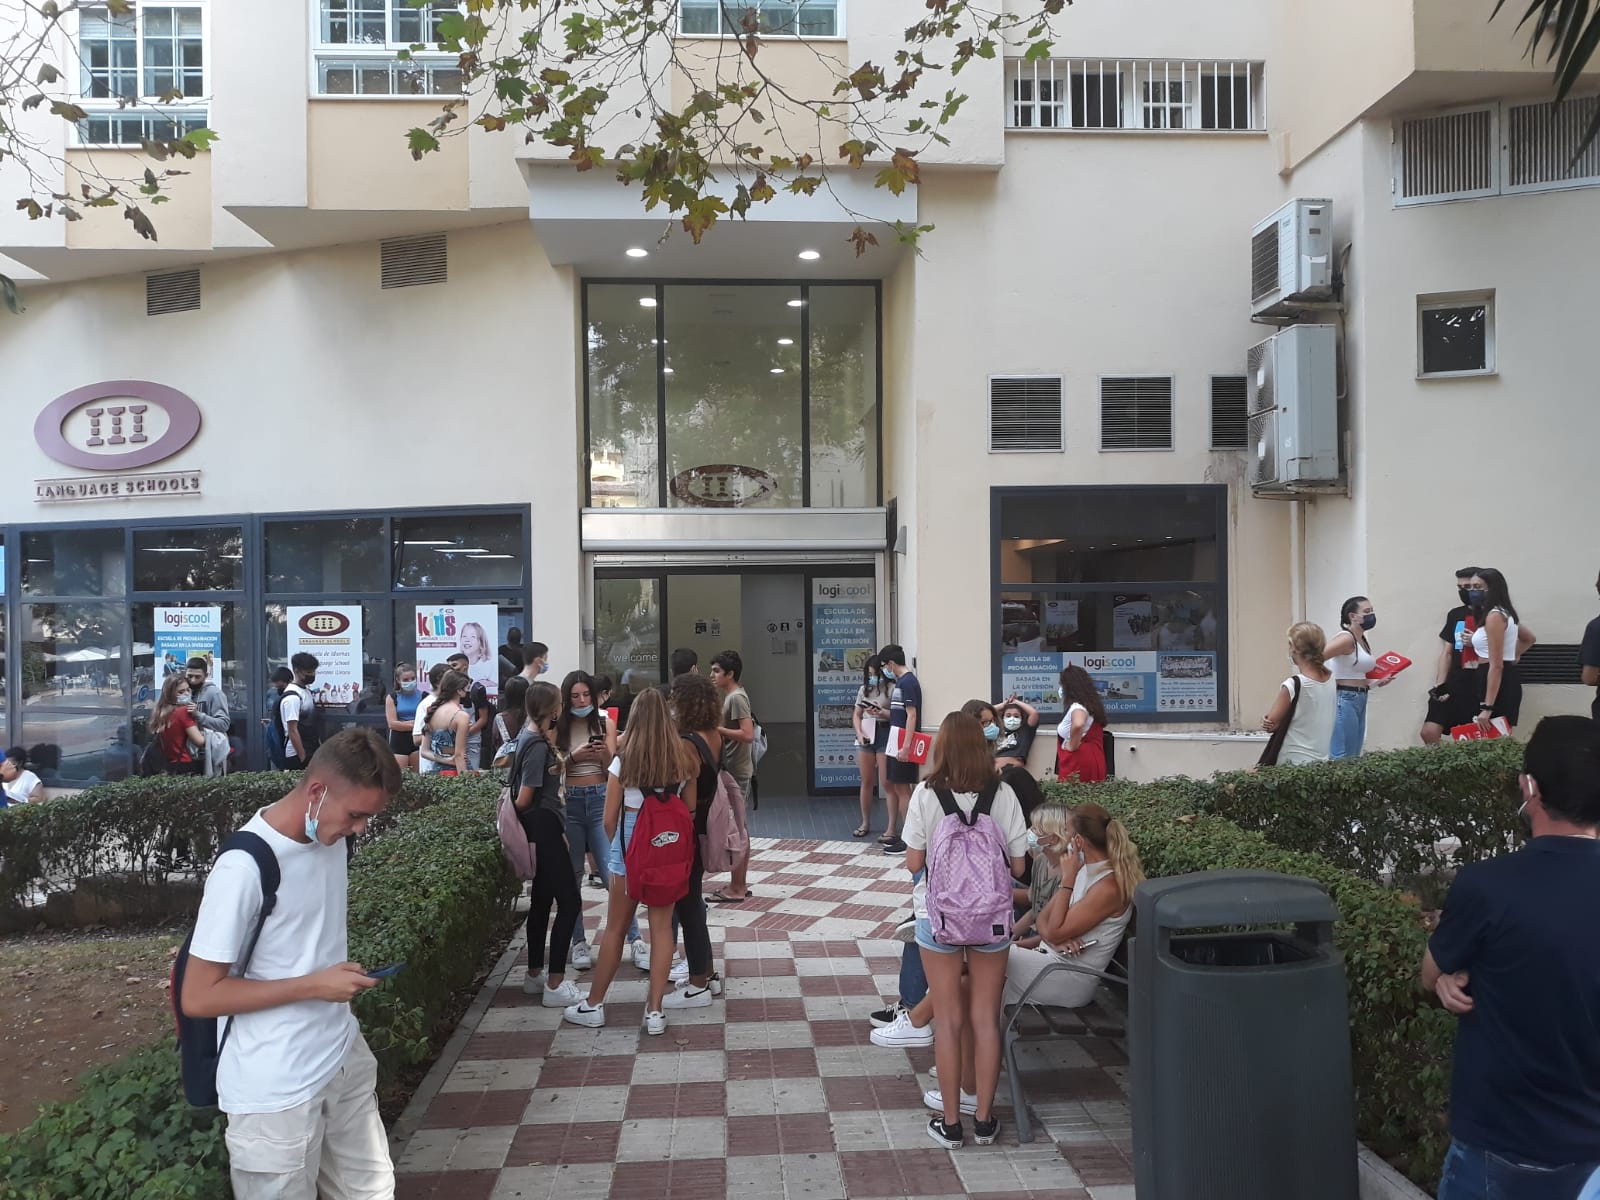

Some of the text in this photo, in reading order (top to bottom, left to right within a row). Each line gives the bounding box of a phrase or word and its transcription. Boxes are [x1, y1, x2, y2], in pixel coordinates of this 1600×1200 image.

[36, 478, 200, 498] LANGUAGE SCHOOLS
[819, 584, 871, 598] logiscool
[164, 610, 210, 627] logiscool
[825, 627, 854, 635] BASADA
[821, 637, 831, 645] LA
[613, 653, 658, 662] welcome
[1083, 655, 1136, 670] logiscool
